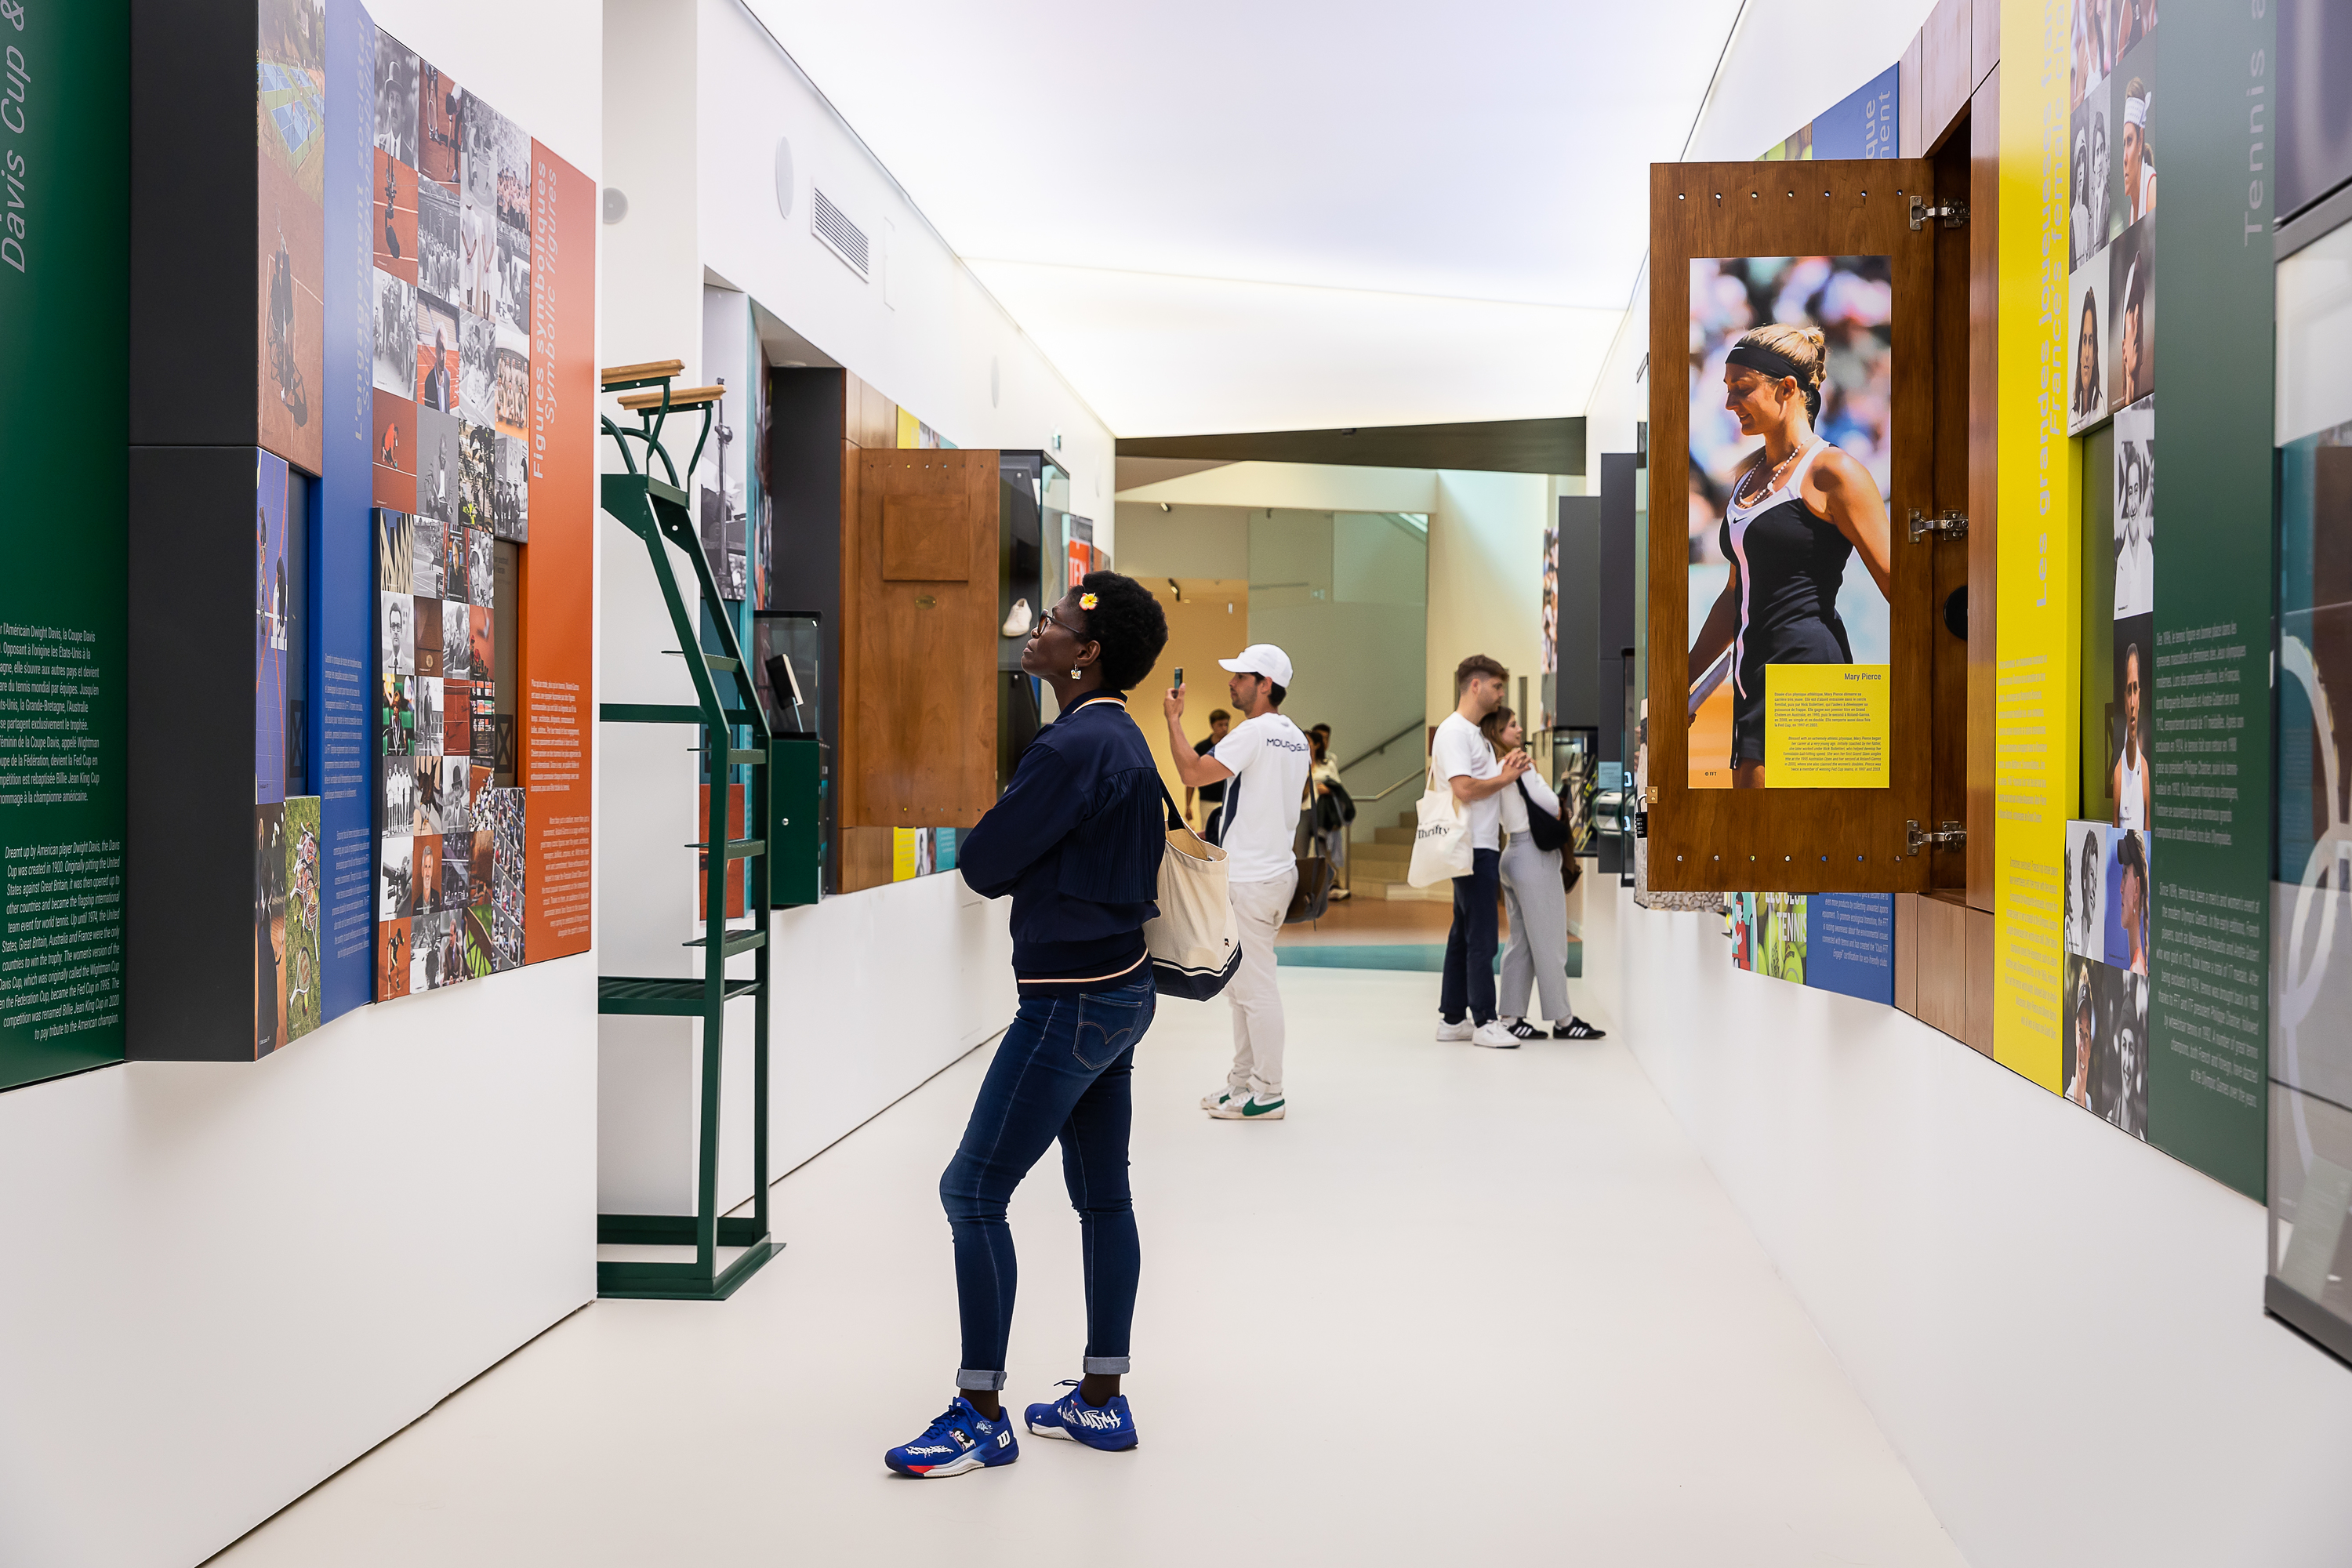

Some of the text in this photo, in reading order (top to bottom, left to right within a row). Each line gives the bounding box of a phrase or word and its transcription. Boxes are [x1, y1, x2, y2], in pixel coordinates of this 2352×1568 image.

[0, 0, 31, 274] Davis Cup &
[2244, 48, 2265, 248] Tennis
[2051, 96, 2063, 244] female
[2039, 101, 2052, 326] joueuses
[545, 169, 558, 424] Symbolic figures
[355, 183, 365, 441] L'engagement
[533, 161, 547, 479] Figures symboliques
[362, 296, 371, 411] Social
[2049, 261, 2062, 435] France's
[2038, 339, 2050, 516] grandes
[2036, 532, 2048, 607] Les
[3, 622, 30, 637] l'Américain
[31, 626, 47, 641] Dwight
[49, 627, 62, 644] Davis,
[68, 629, 82, 644] Coupe
[84, 630, 95, 642] Davis
[4, 641, 27, 657] Opposant
[32, 644, 50, 659] l'origine
[14, 661, 23, 673] elle
[24, 662, 40, 674] s'ouvre
[42, 666, 50, 674] aux
[51, 665, 65, 676] autres
[67, 667, 77, 679] pays
[84, 666, 99, 677] devient
[1844, 673, 1860, 681] Mary
[16, 681, 30, 692] tennis
[31, 681, 50, 693] mondial
[60, 682, 78, 696] équipes.
[80, 684, 99, 697] Jusqu'en
[67, 700, 88, 713] l'Australie
[7, 718, 30, 732] partagent
[71, 719, 89, 732] trophée.
[31, 736, 45, 750] Coupe
[47, 736, 60, 750] Davis,
[62, 736, 76, 750] appelé
[78, 737, 99, 750] Wightman
[24, 754, 49, 768] Fédération,
[51, 754, 67, 766] devient
[31, 772, 55, 787] rebaptisée
[68, 772, 78, 783] Jean
[80, 772, 89, 786] King
[91, 772, 100, 786] Cup
[34, 791, 61, 805] championne
[63, 790, 88, 801] américaine.
[5, 847, 22, 858] Dreamt
[37, 844, 58, 855] American
[59, 843, 72, 857] player
[74, 841, 88, 855] Dwight
[89, 841, 100, 852] Davis,
[109, 840, 120, 851] Davis
[8, 865, 16, 880] Cup
[18, 866, 27, 876] was
[28, 862, 45, 875] created
[53, 861, 64, 873] 1900.
[107, 857, 120, 868] United
[7, 884, 21, 895] States
[23, 882, 39, 897] against
[41, 880, 53, 892] Great
[54, 879, 68, 891] Britain,
[74, 880, 82, 888] was
[83, 877, 93, 887] then
[93, 875, 108, 889] opened
[6, 902, 19, 914] other
[20, 900, 41, 913] countries
[42, 898, 50, 910] and
[52, 898, 69, 909] became
[8, 923, 20, 933] team
[21, 920, 33, 931] event
[42, 916, 55, 928] world
[56, 915, 69, 927] tennis.
[78, 912, 87, 924] until
[88, 911, 99, 923] 1974,
[107, 908, 120, 920] United
[1777, 912, 1807, 942] TENNIS
